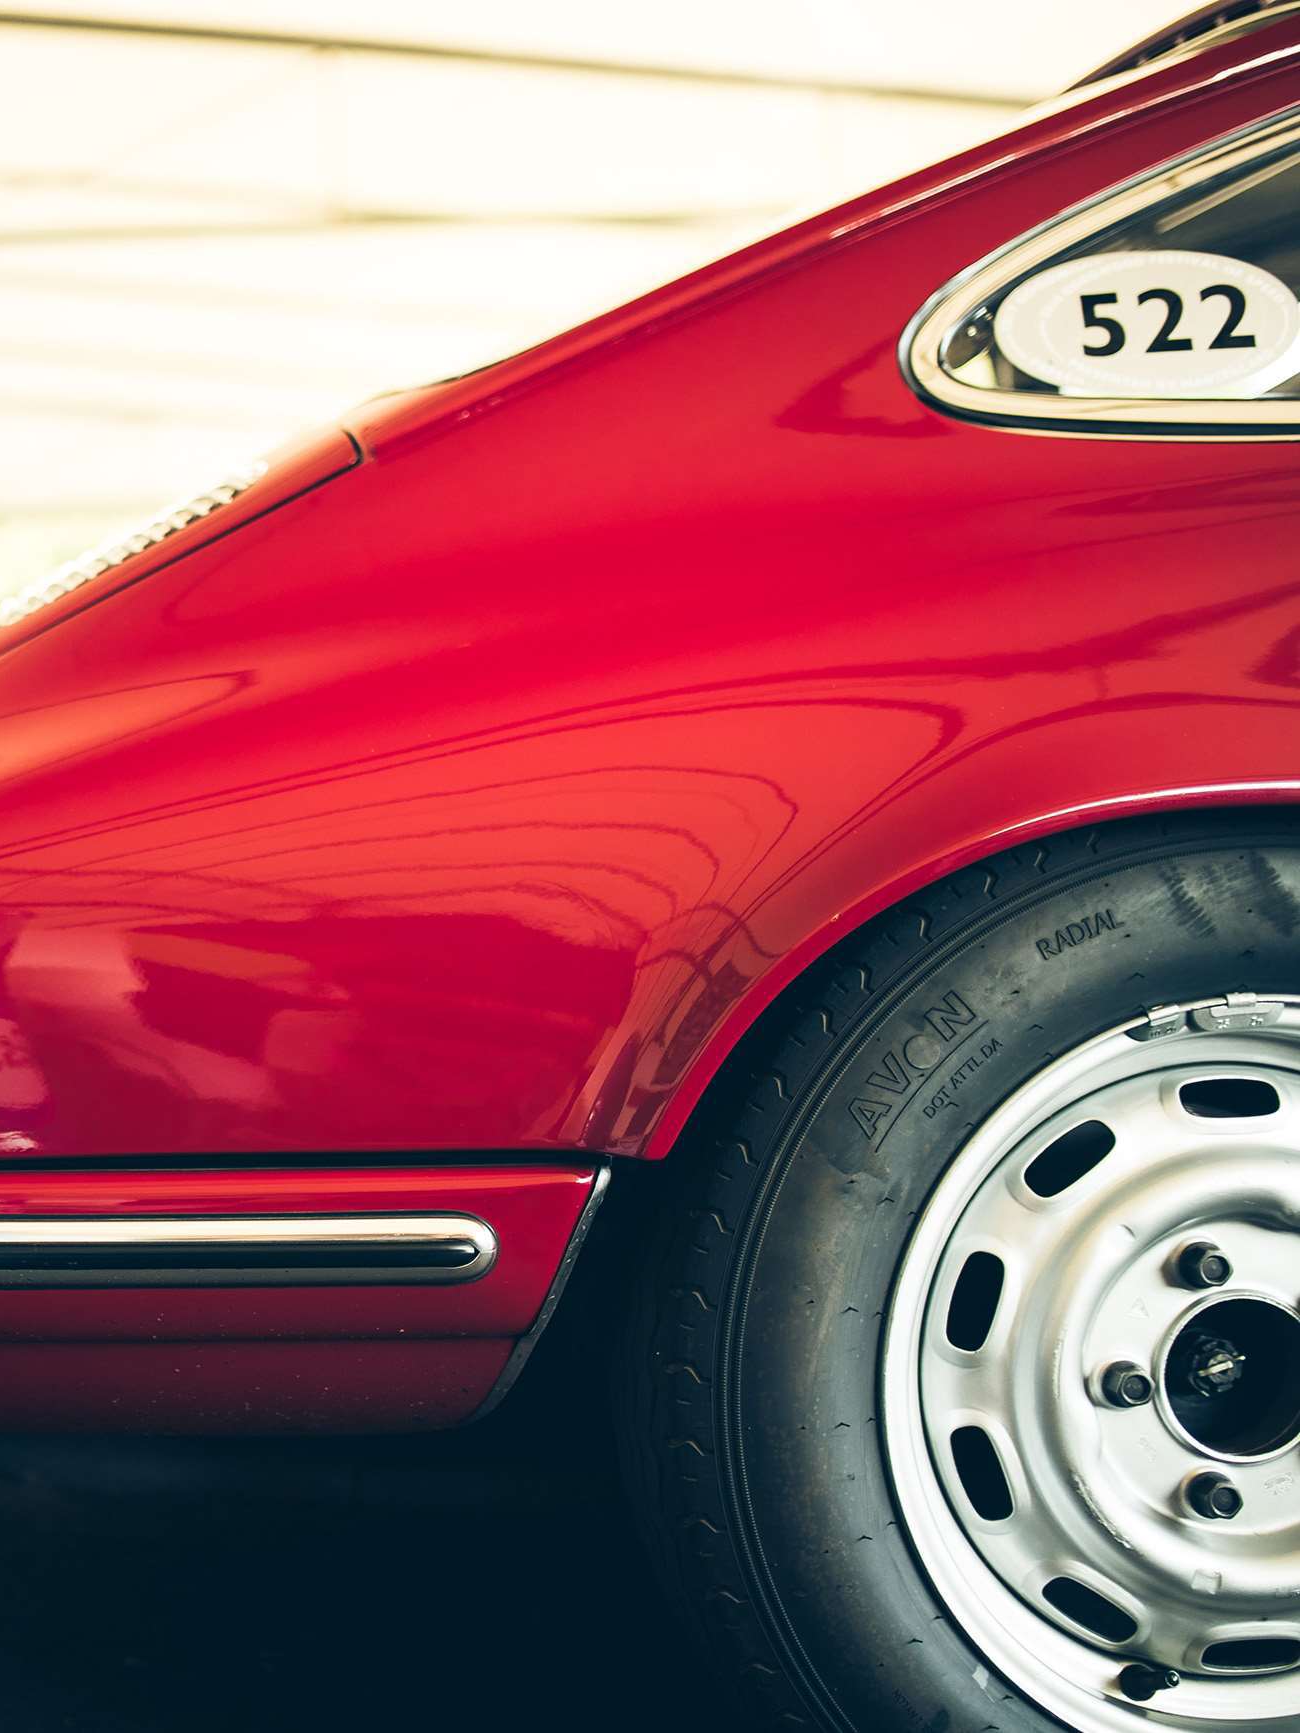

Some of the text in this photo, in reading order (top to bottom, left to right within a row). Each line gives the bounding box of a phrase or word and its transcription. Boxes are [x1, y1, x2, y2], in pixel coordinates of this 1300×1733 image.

[1079, 284, 1257, 357] 522
[1035, 908, 1125, 961] RADIAL
[847, 989, 977, 1141] AVON
[922, 1085, 951, 1119] DOT
